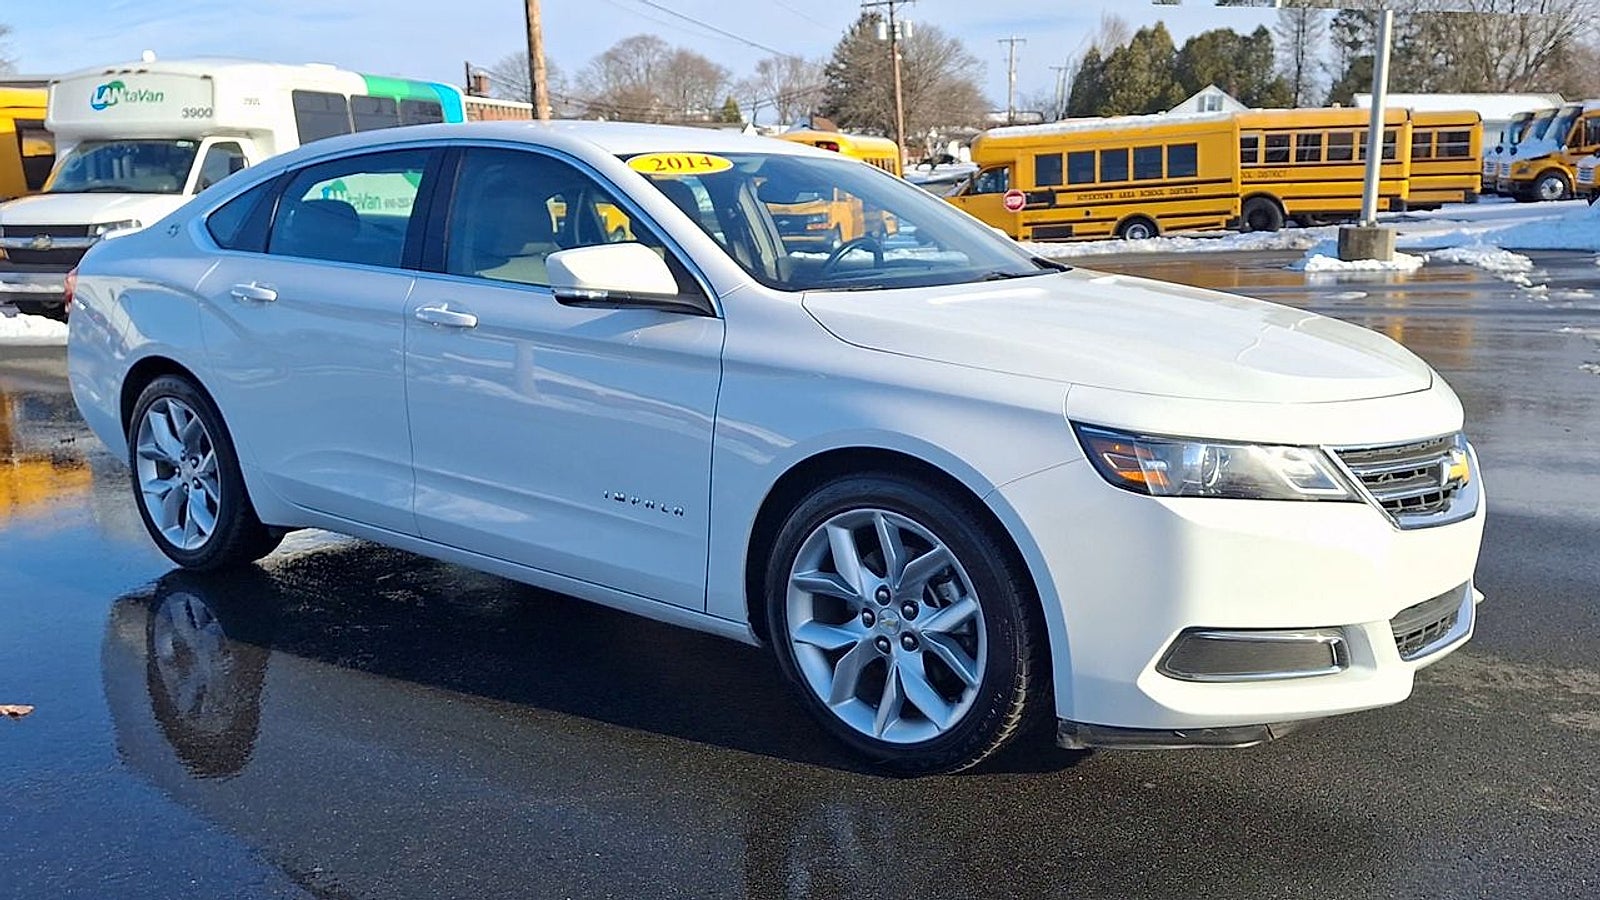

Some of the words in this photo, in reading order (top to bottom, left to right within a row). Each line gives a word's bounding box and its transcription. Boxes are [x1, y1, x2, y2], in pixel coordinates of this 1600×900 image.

[649, 155, 713, 171] 2014
[1140, 189, 1165, 198] SCHOOL
[1169, 186, 1199, 196] DISTRICT
[1006, 196, 1022, 205] STOP
[603, 490, 684, 516] IMPALA
